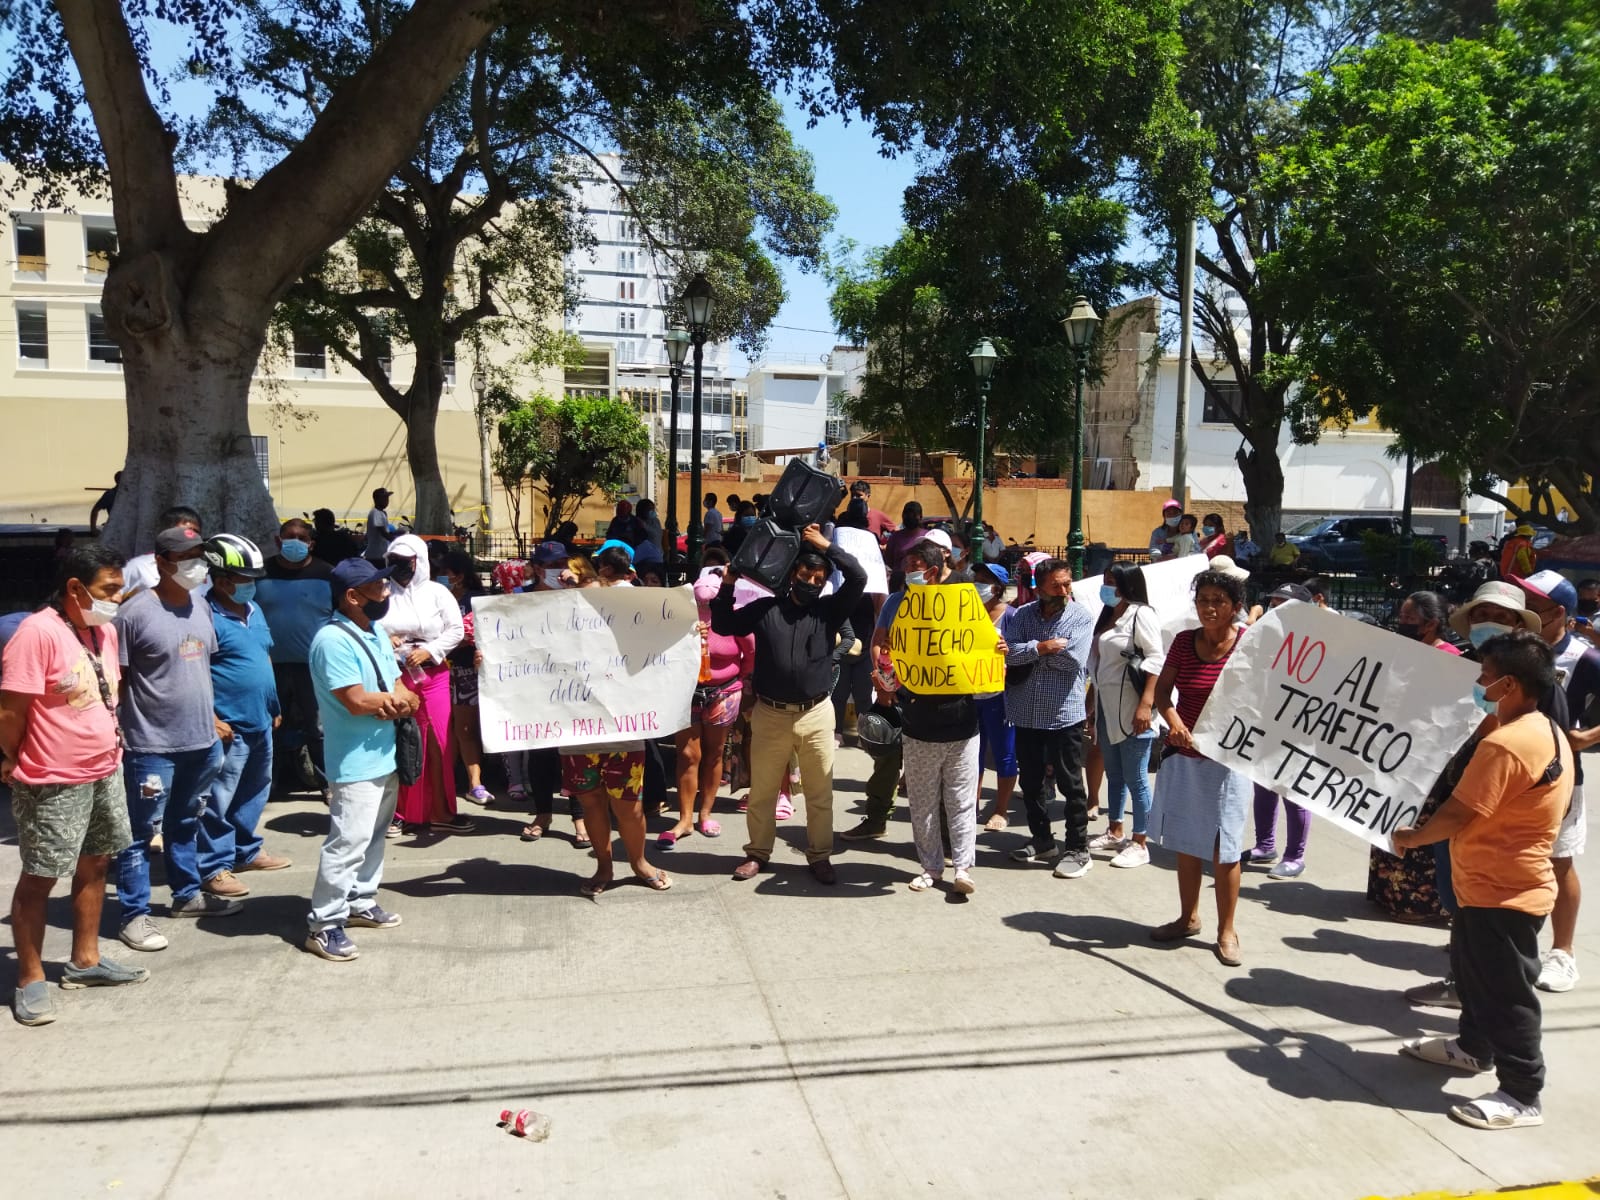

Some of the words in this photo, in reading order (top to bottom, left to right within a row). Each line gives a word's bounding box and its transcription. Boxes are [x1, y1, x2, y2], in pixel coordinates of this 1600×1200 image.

[898, 592, 946, 622] SOLO
[912, 626, 975, 656] TECHO
[896, 659, 957, 688] DONDE
[1272, 631, 1326, 684] NO
[1334, 656, 1383, 713] AL
[503, 719, 562, 741] TIERRAS
[572, 716, 607, 737] PARA
[614, 710, 660, 733] VIVIR
[1218, 716, 1266, 761] DE
[1274, 684, 1413, 774] TRAFICO
